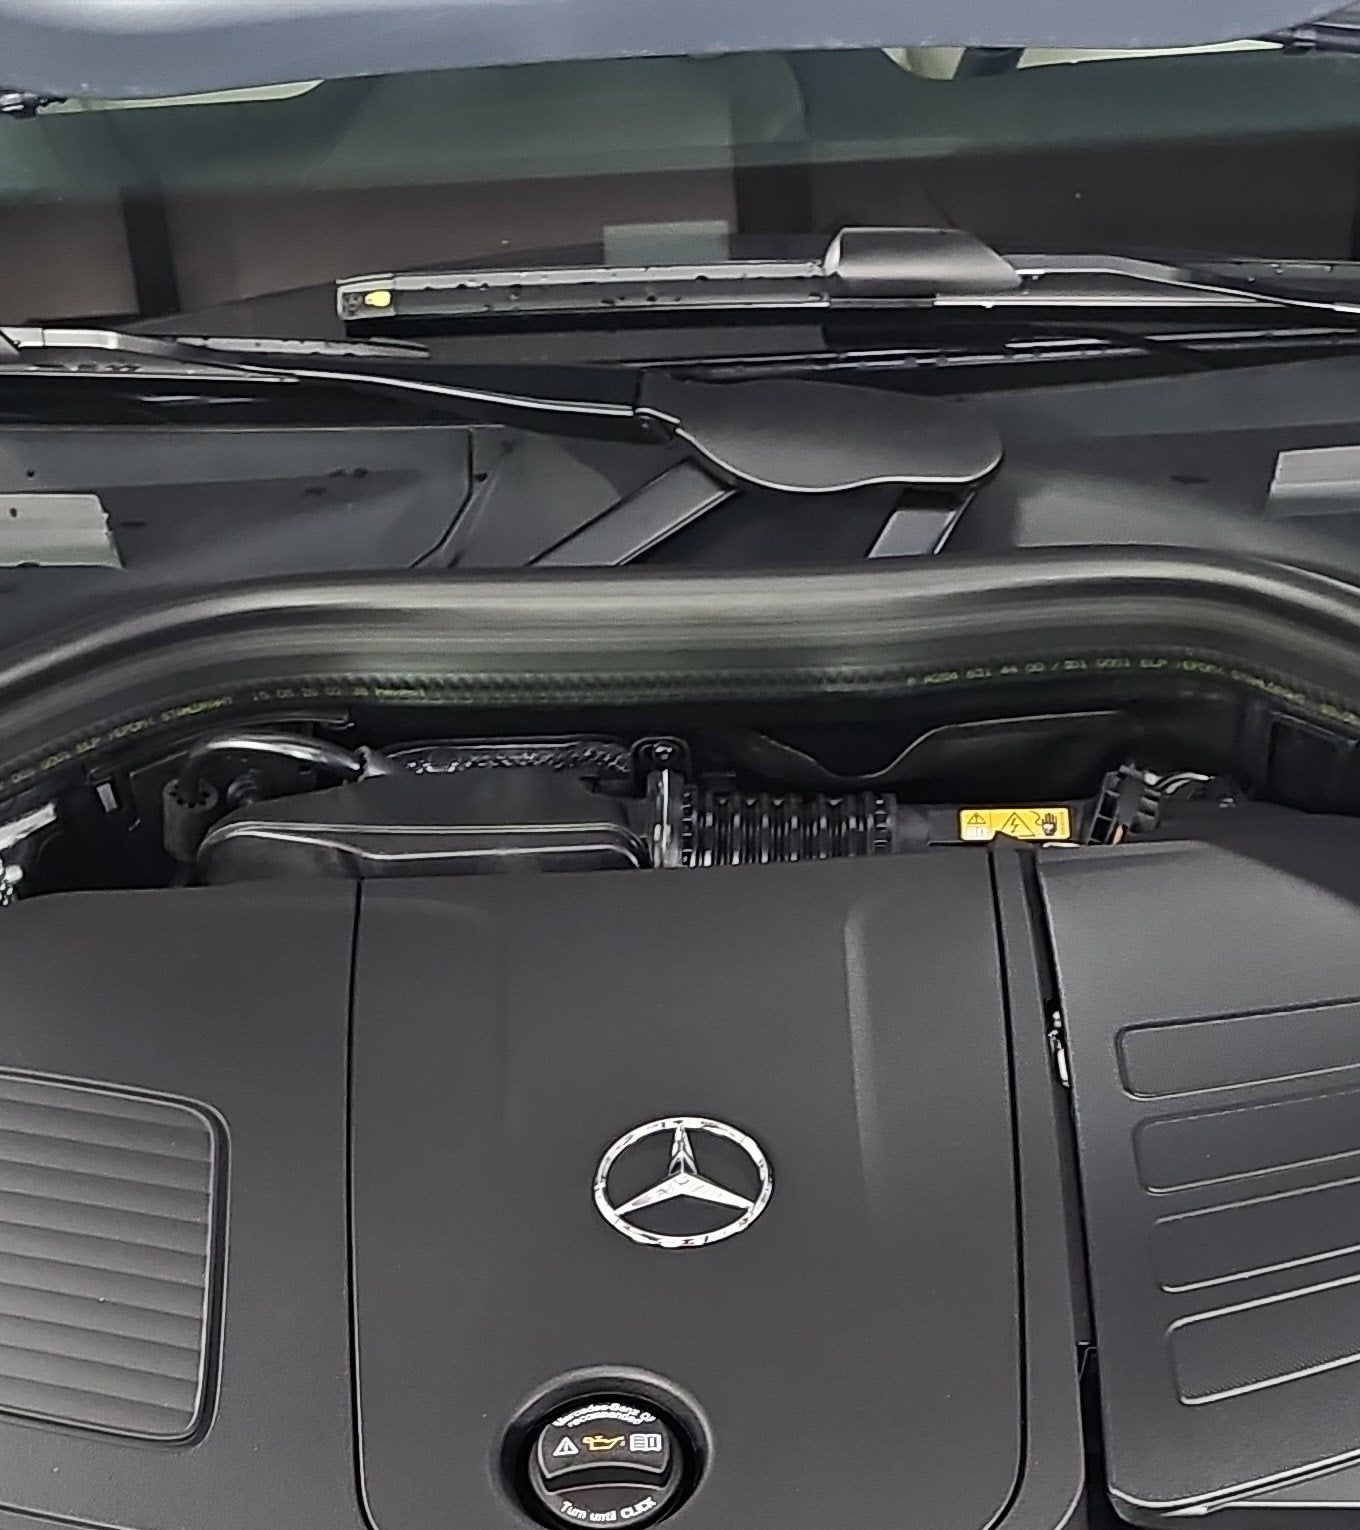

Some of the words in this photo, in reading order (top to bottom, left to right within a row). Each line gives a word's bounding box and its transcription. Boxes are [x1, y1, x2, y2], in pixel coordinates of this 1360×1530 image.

[566, 1410, 644, 1428] recommended
[560, 1500, 587, 1520] Turn
[589, 1509, 617, 1521] until
[620, 1496, 657, 1519] CLICK
